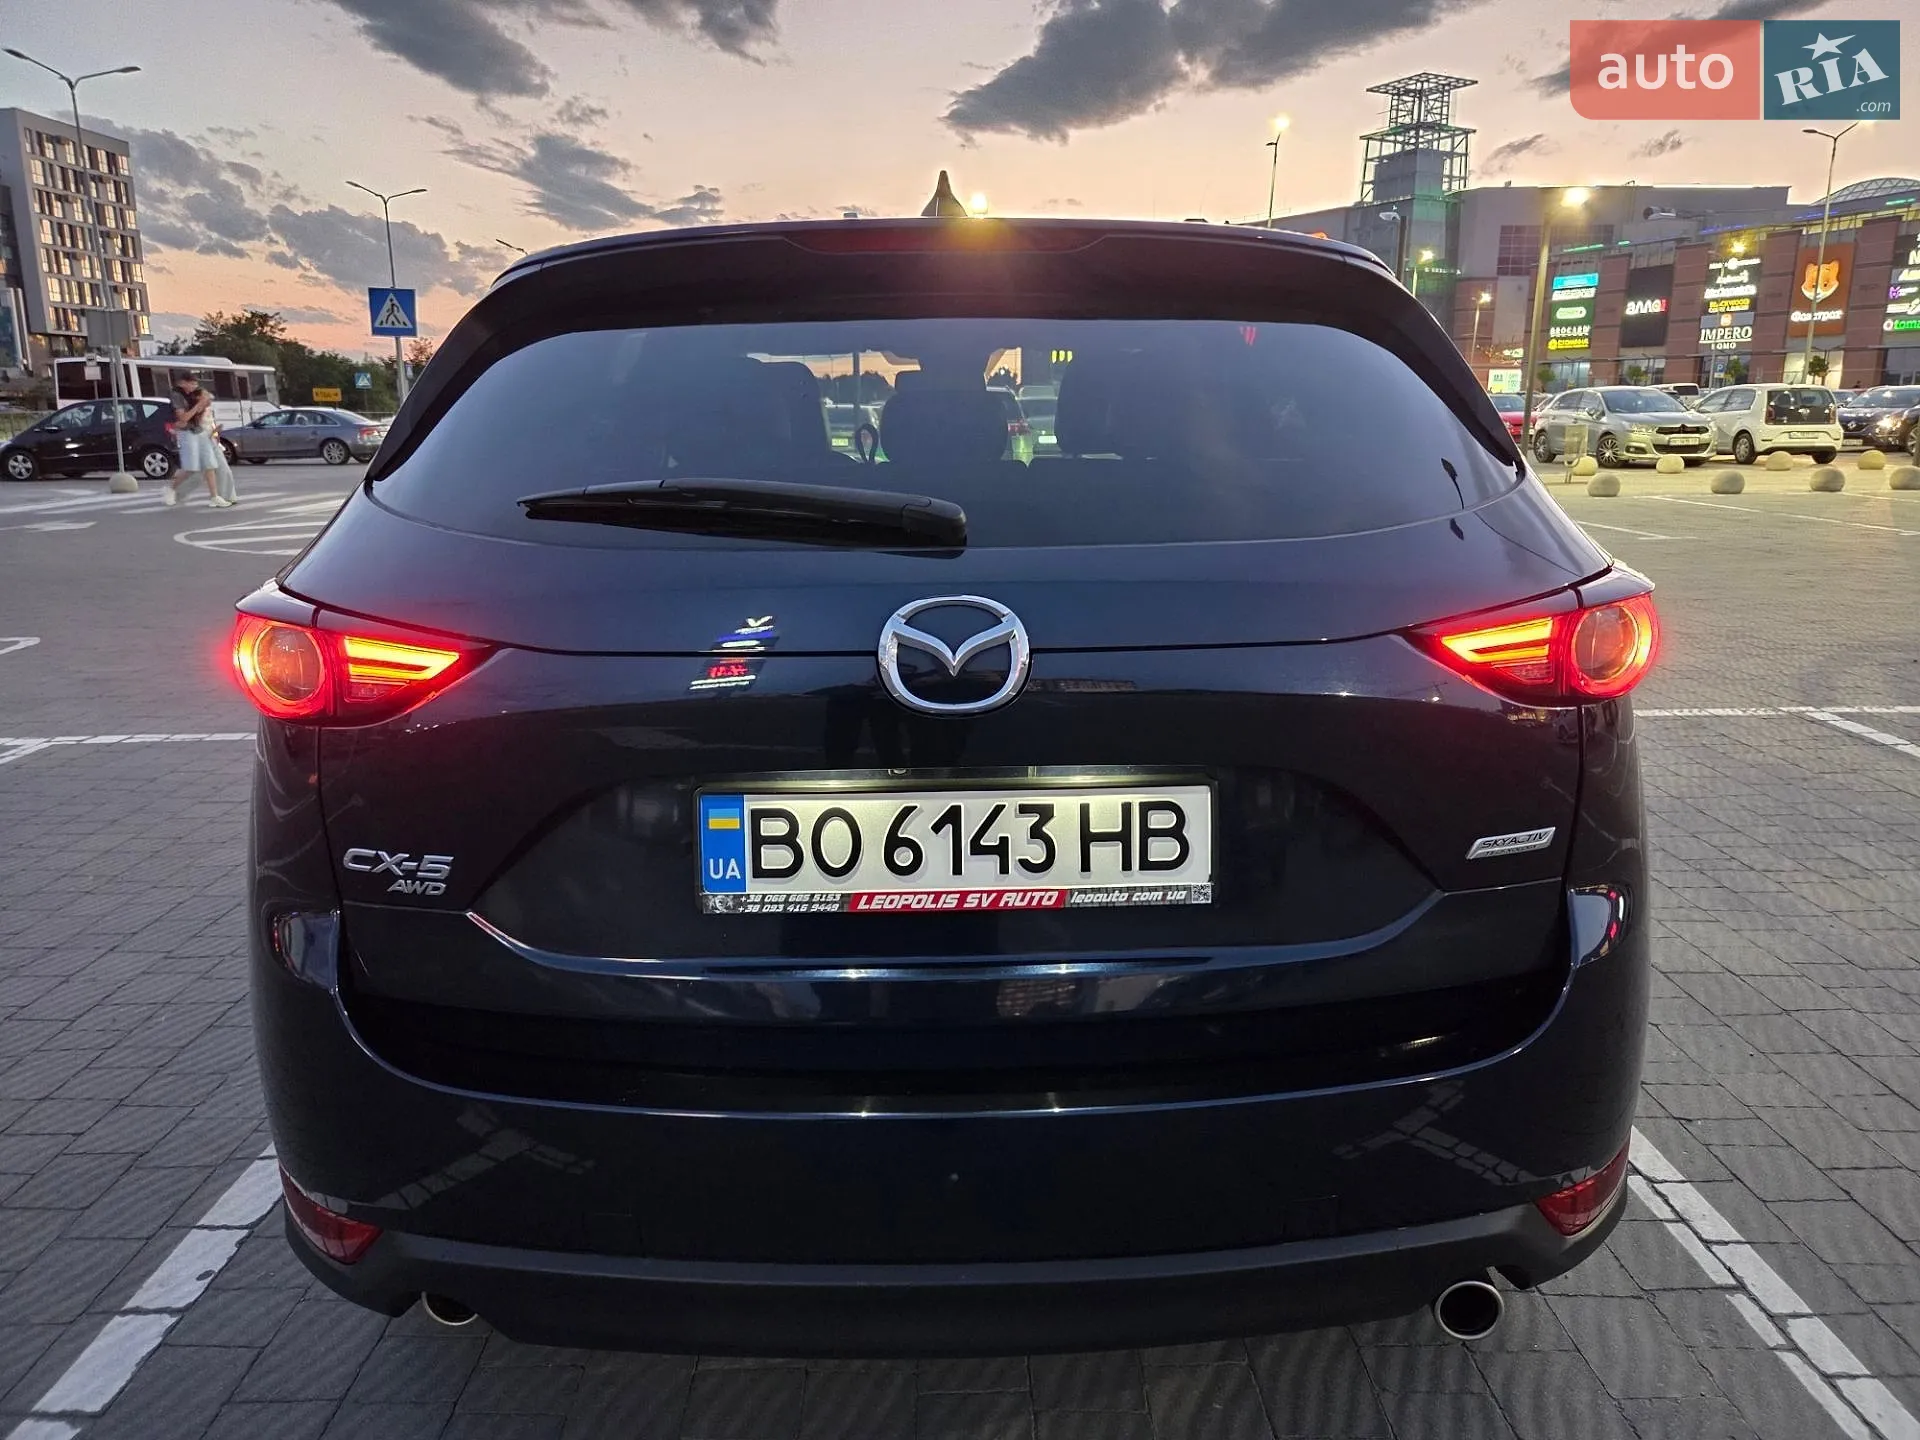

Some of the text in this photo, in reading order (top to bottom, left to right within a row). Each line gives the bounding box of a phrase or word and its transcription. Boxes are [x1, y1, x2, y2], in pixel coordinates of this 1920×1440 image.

[1700, 326, 1752, 341] IMPERO
[750, 800, 1190, 879] BO 6143 HB
[1482, 832, 1548, 848] SKYACTIV
[343, 848, 454, 879] CX-5
[709, 858, 741, 879] UA
[387, 879, 447, 896] AWD
[738, 904, 760, 912] +38
[857, 890, 1060, 910] LEOPOLIS SV AUTO
